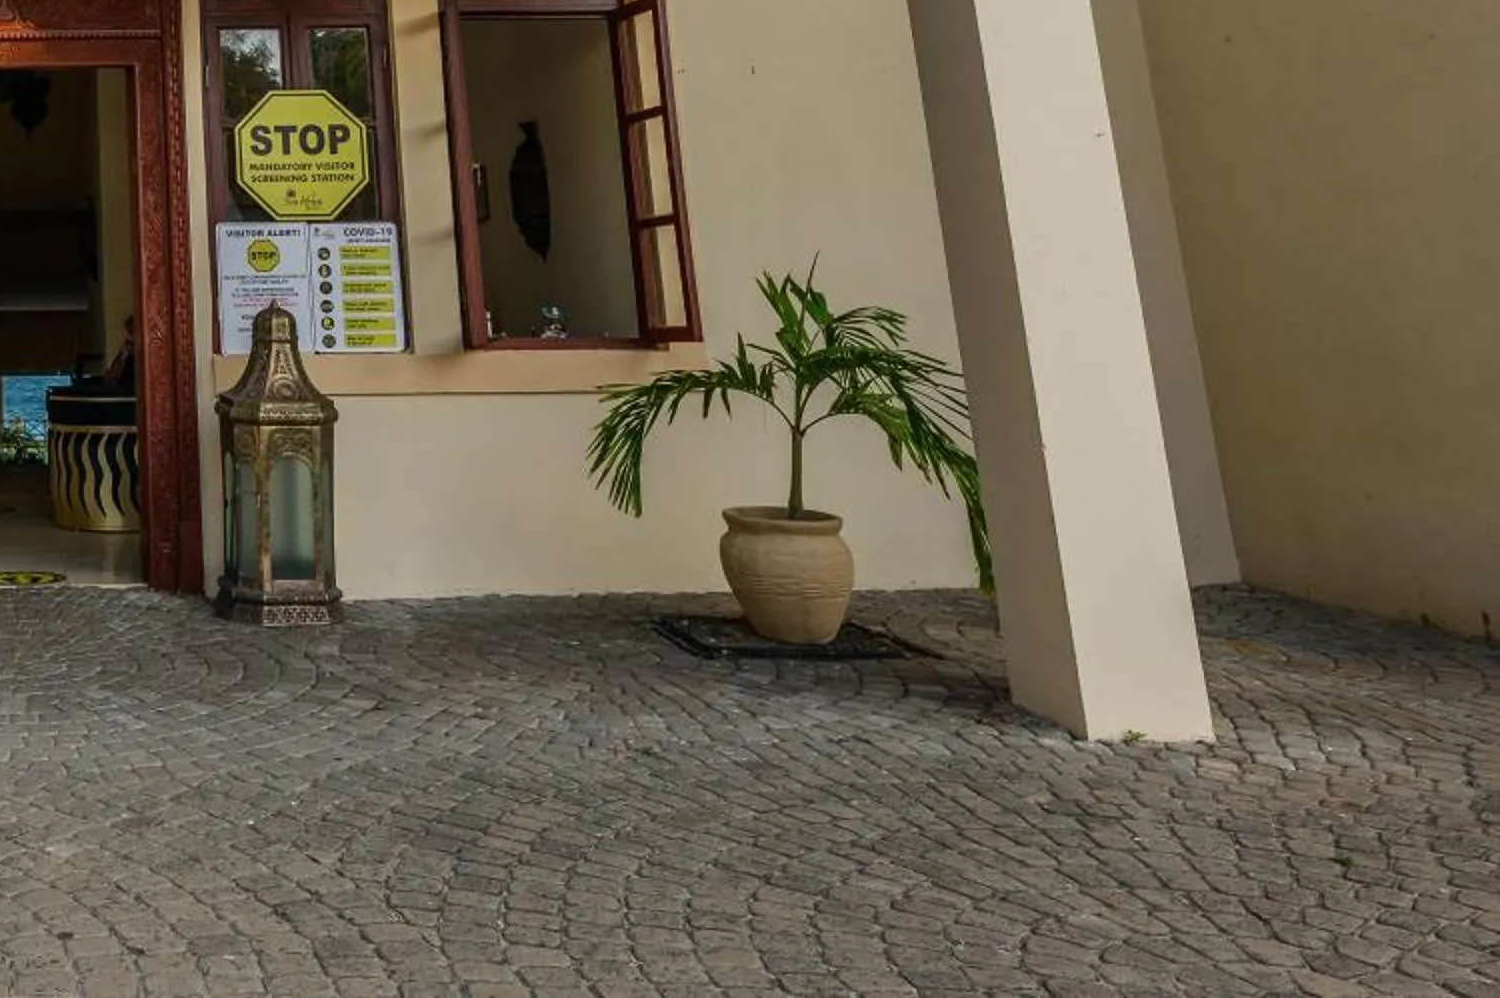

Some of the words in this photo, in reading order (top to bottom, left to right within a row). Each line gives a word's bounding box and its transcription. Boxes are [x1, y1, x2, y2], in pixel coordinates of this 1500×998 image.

[250, 124, 350, 156] STOP
[249, 163, 313, 171] MANDATORY
[315, 162, 355, 170] VISITOR
[250, 174, 308, 183] SCREENING
[311, 173, 355, 182] STATION
[343, 227, 393, 237] COVID-19
